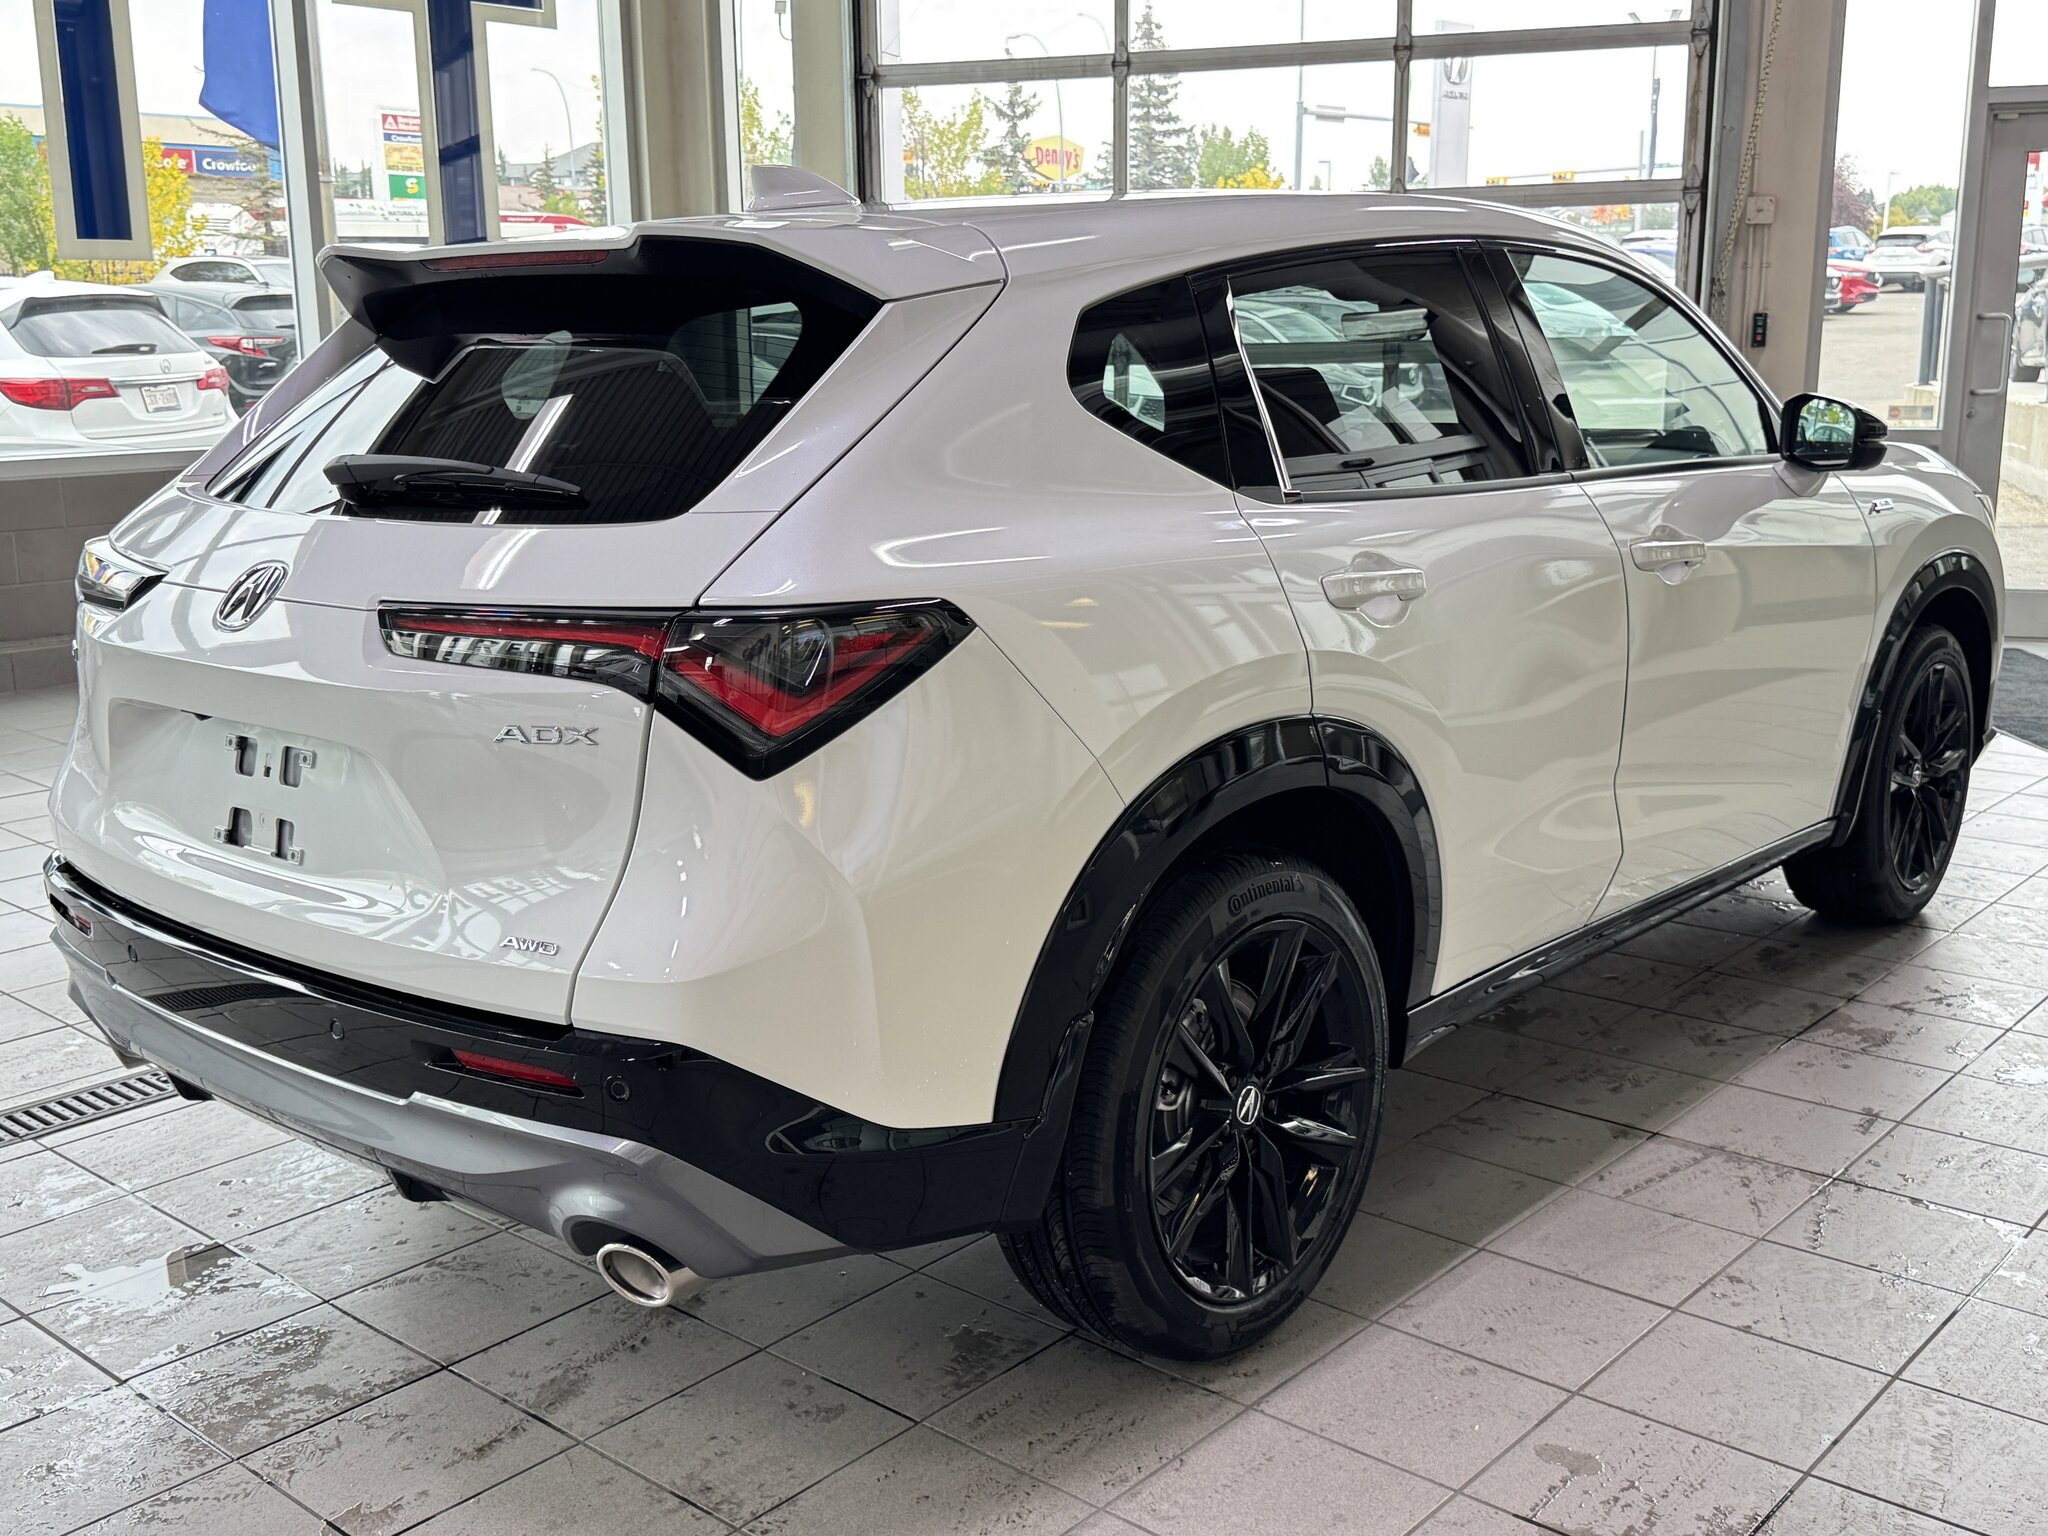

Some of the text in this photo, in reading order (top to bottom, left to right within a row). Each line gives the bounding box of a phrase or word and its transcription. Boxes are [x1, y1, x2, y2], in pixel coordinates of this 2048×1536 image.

[493, 724, 600, 746] ADX
[1227, 875, 1296, 917] Continental
[499, 935, 560, 957] AWD
